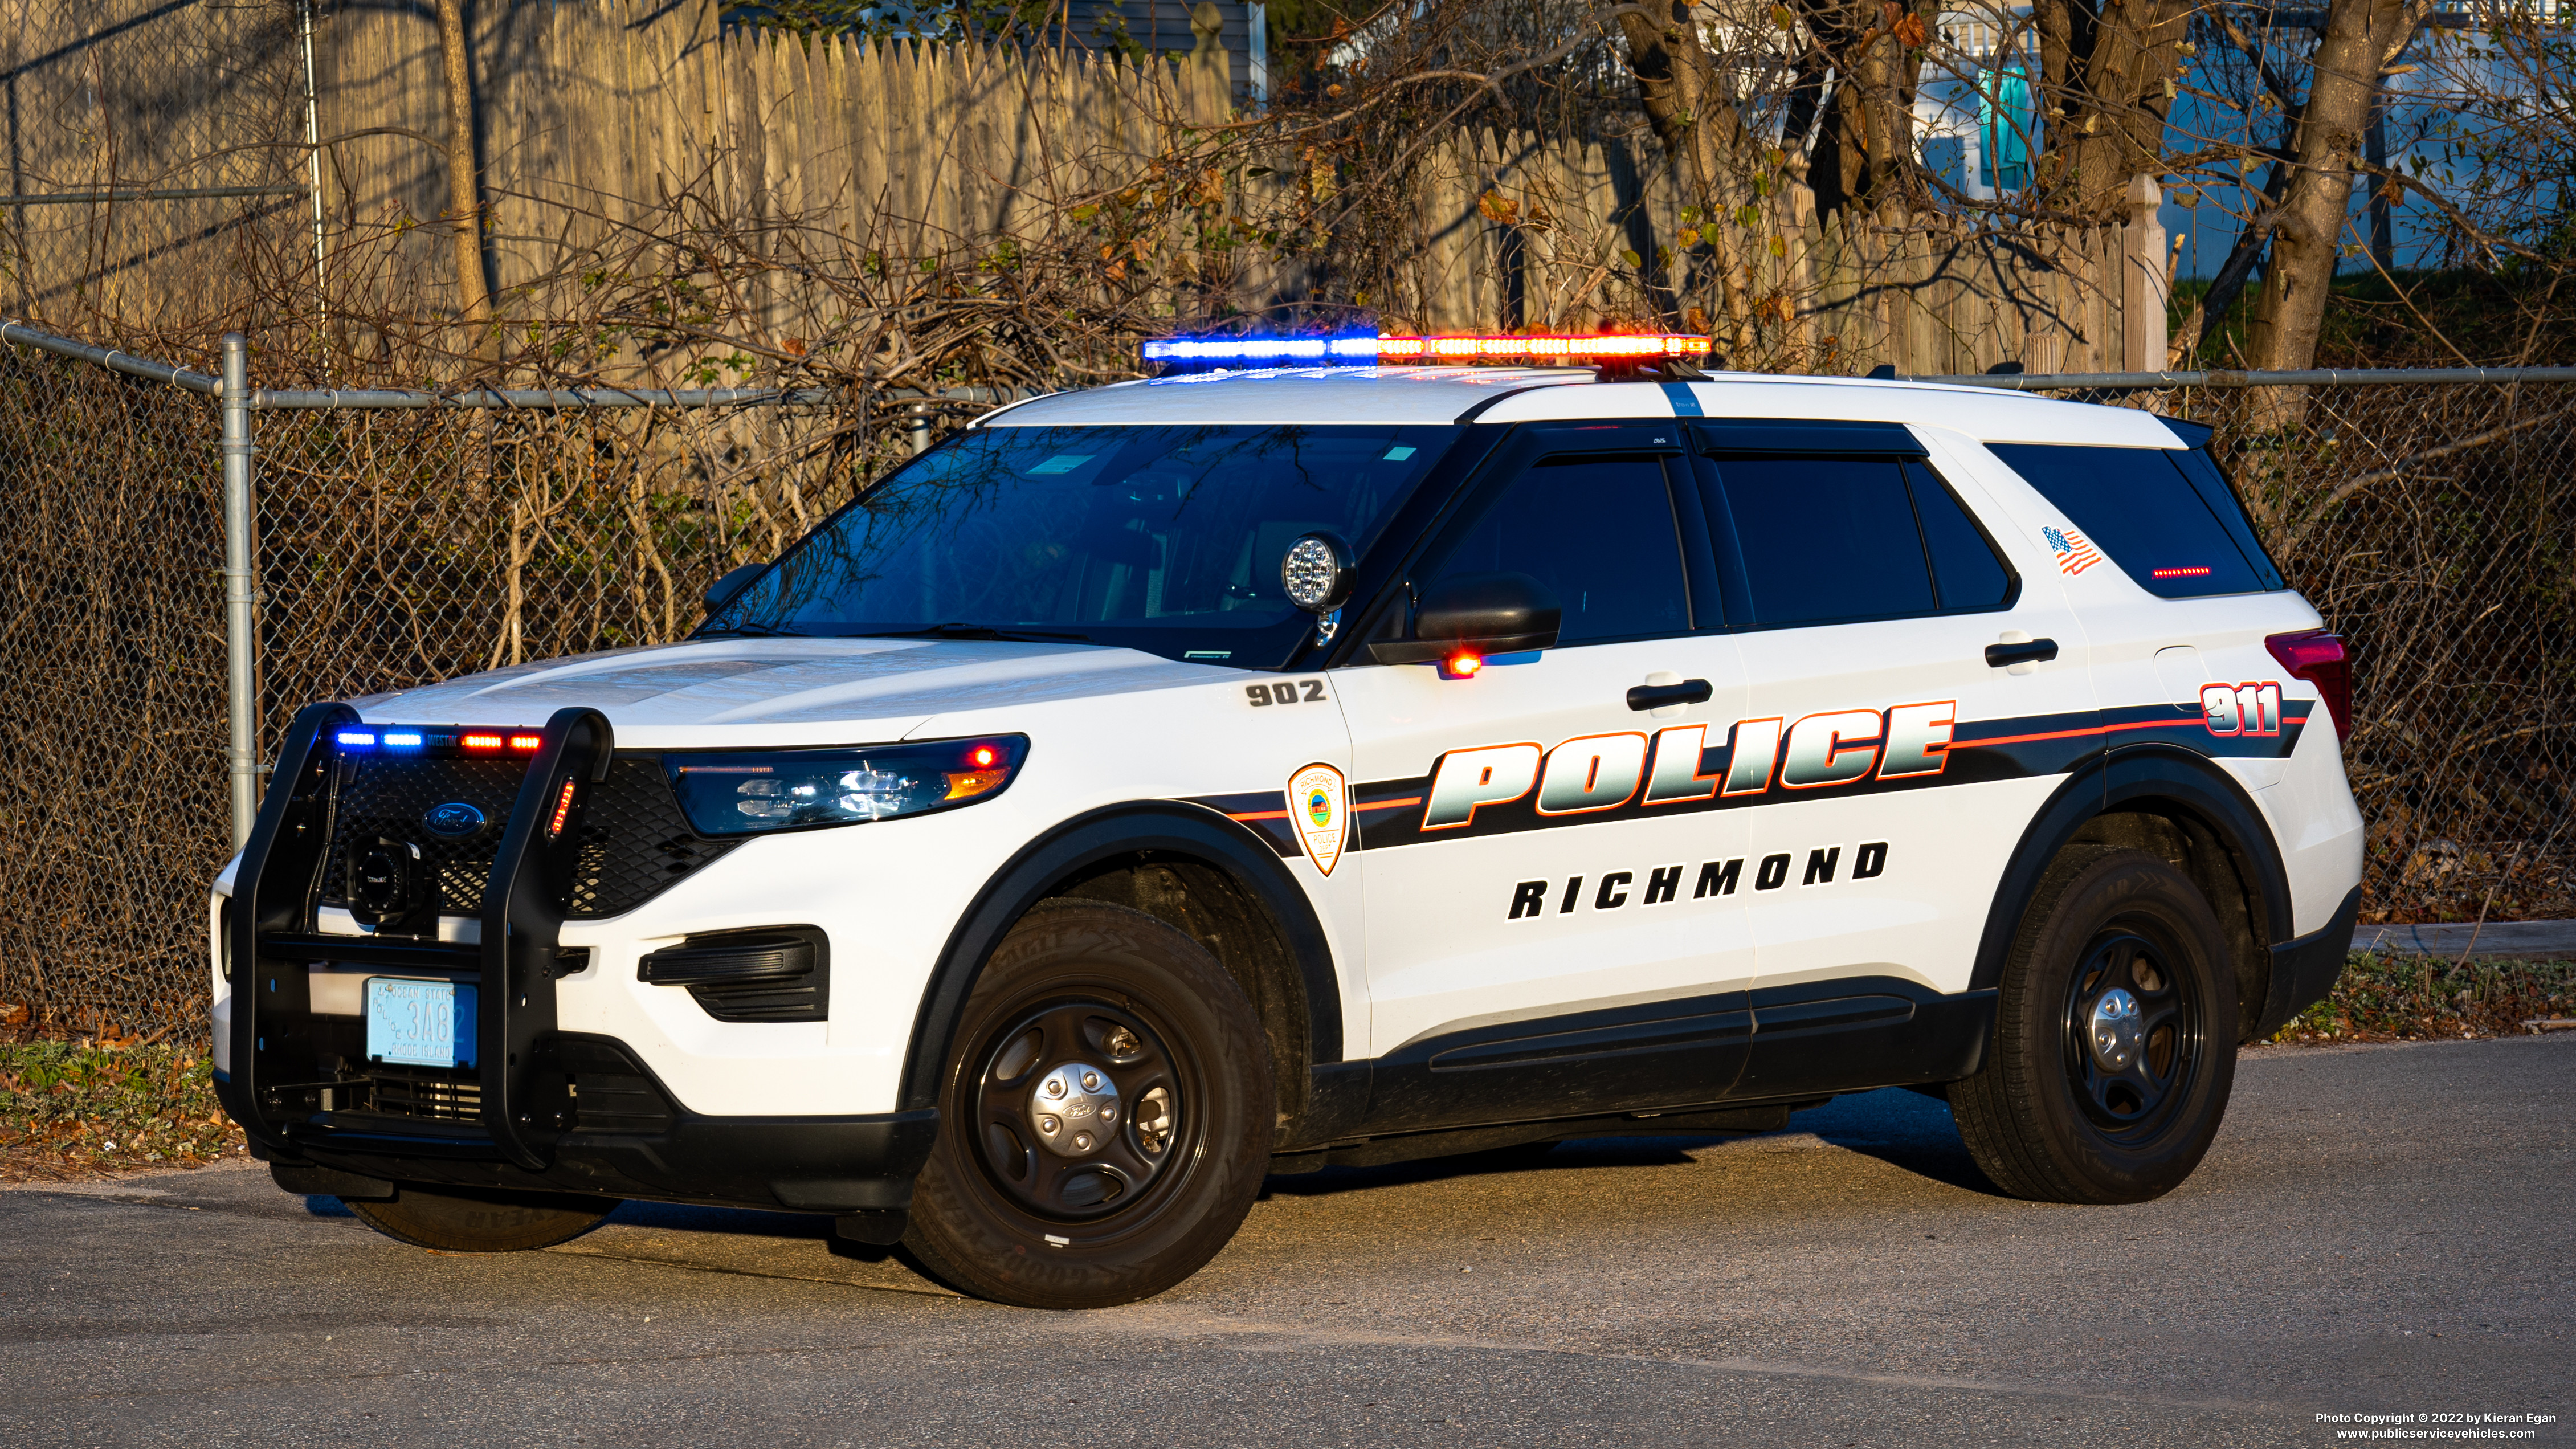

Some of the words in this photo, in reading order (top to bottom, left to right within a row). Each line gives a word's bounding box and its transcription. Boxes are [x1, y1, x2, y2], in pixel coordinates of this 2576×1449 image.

[1246, 680, 1326, 707] 902
[2200, 681, 2280, 737] 911
[1300, 775, 1333, 789] RICHMOND
[1419, 699, 1957, 832] POLICE
[1313, 832, 1336, 844] POLICE
[1508, 842, 1888, 920] RICHMOND
[989, 931, 1067, 977] EAGLE
[392, 986, 419, 999] OCEAN
[425, 988, 451, 1001] STATE
[407, 1001, 464, 1043] 3A82
[392, 1043, 418, 1057] RHODE
[422, 1045, 451, 1059] ISLAND
